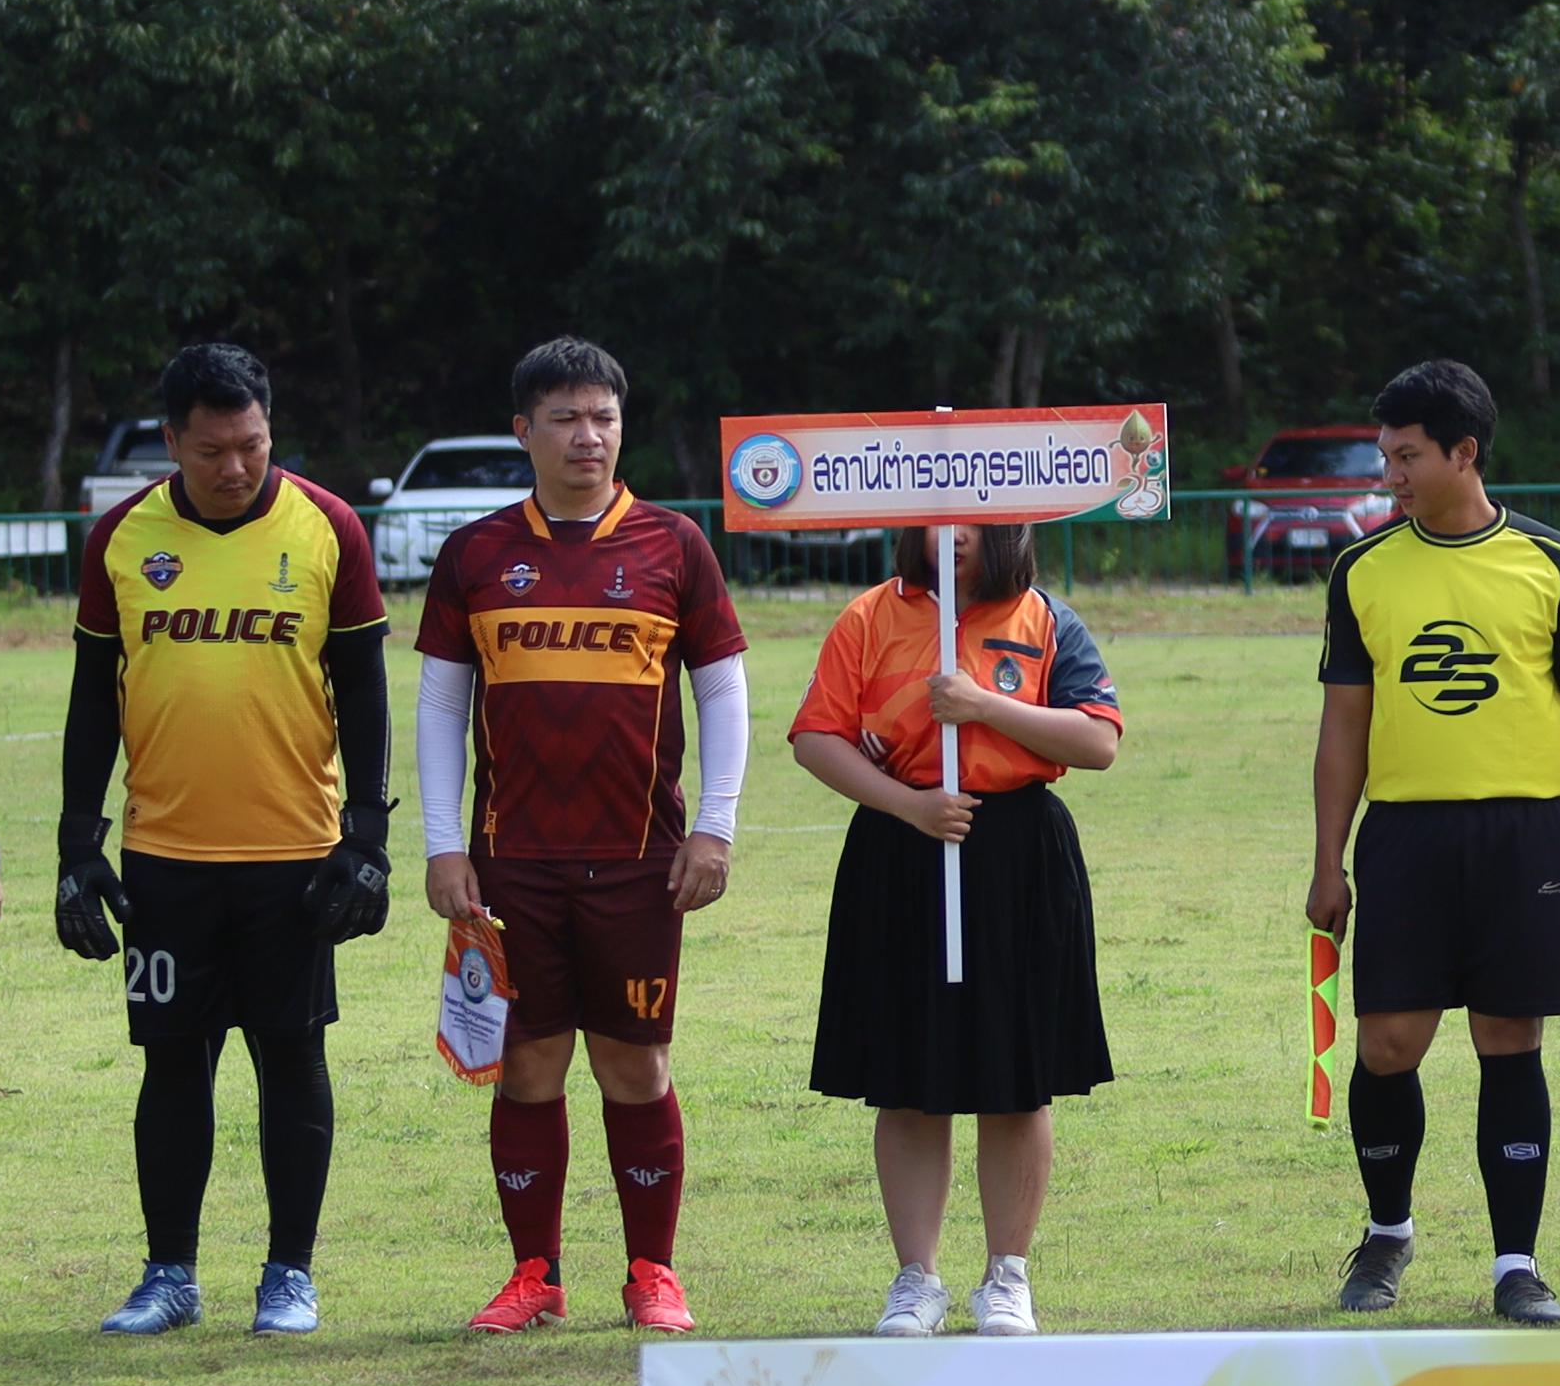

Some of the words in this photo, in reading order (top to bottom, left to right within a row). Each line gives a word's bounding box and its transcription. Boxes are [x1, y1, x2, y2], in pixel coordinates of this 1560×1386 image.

[812, 436, 1110, 502] สถานีตำรวจภูธรแม่สอด
[142, 608, 305, 646] POLICE
[497, 621, 640, 653] POLICE
[126, 946, 176, 1003] 20
